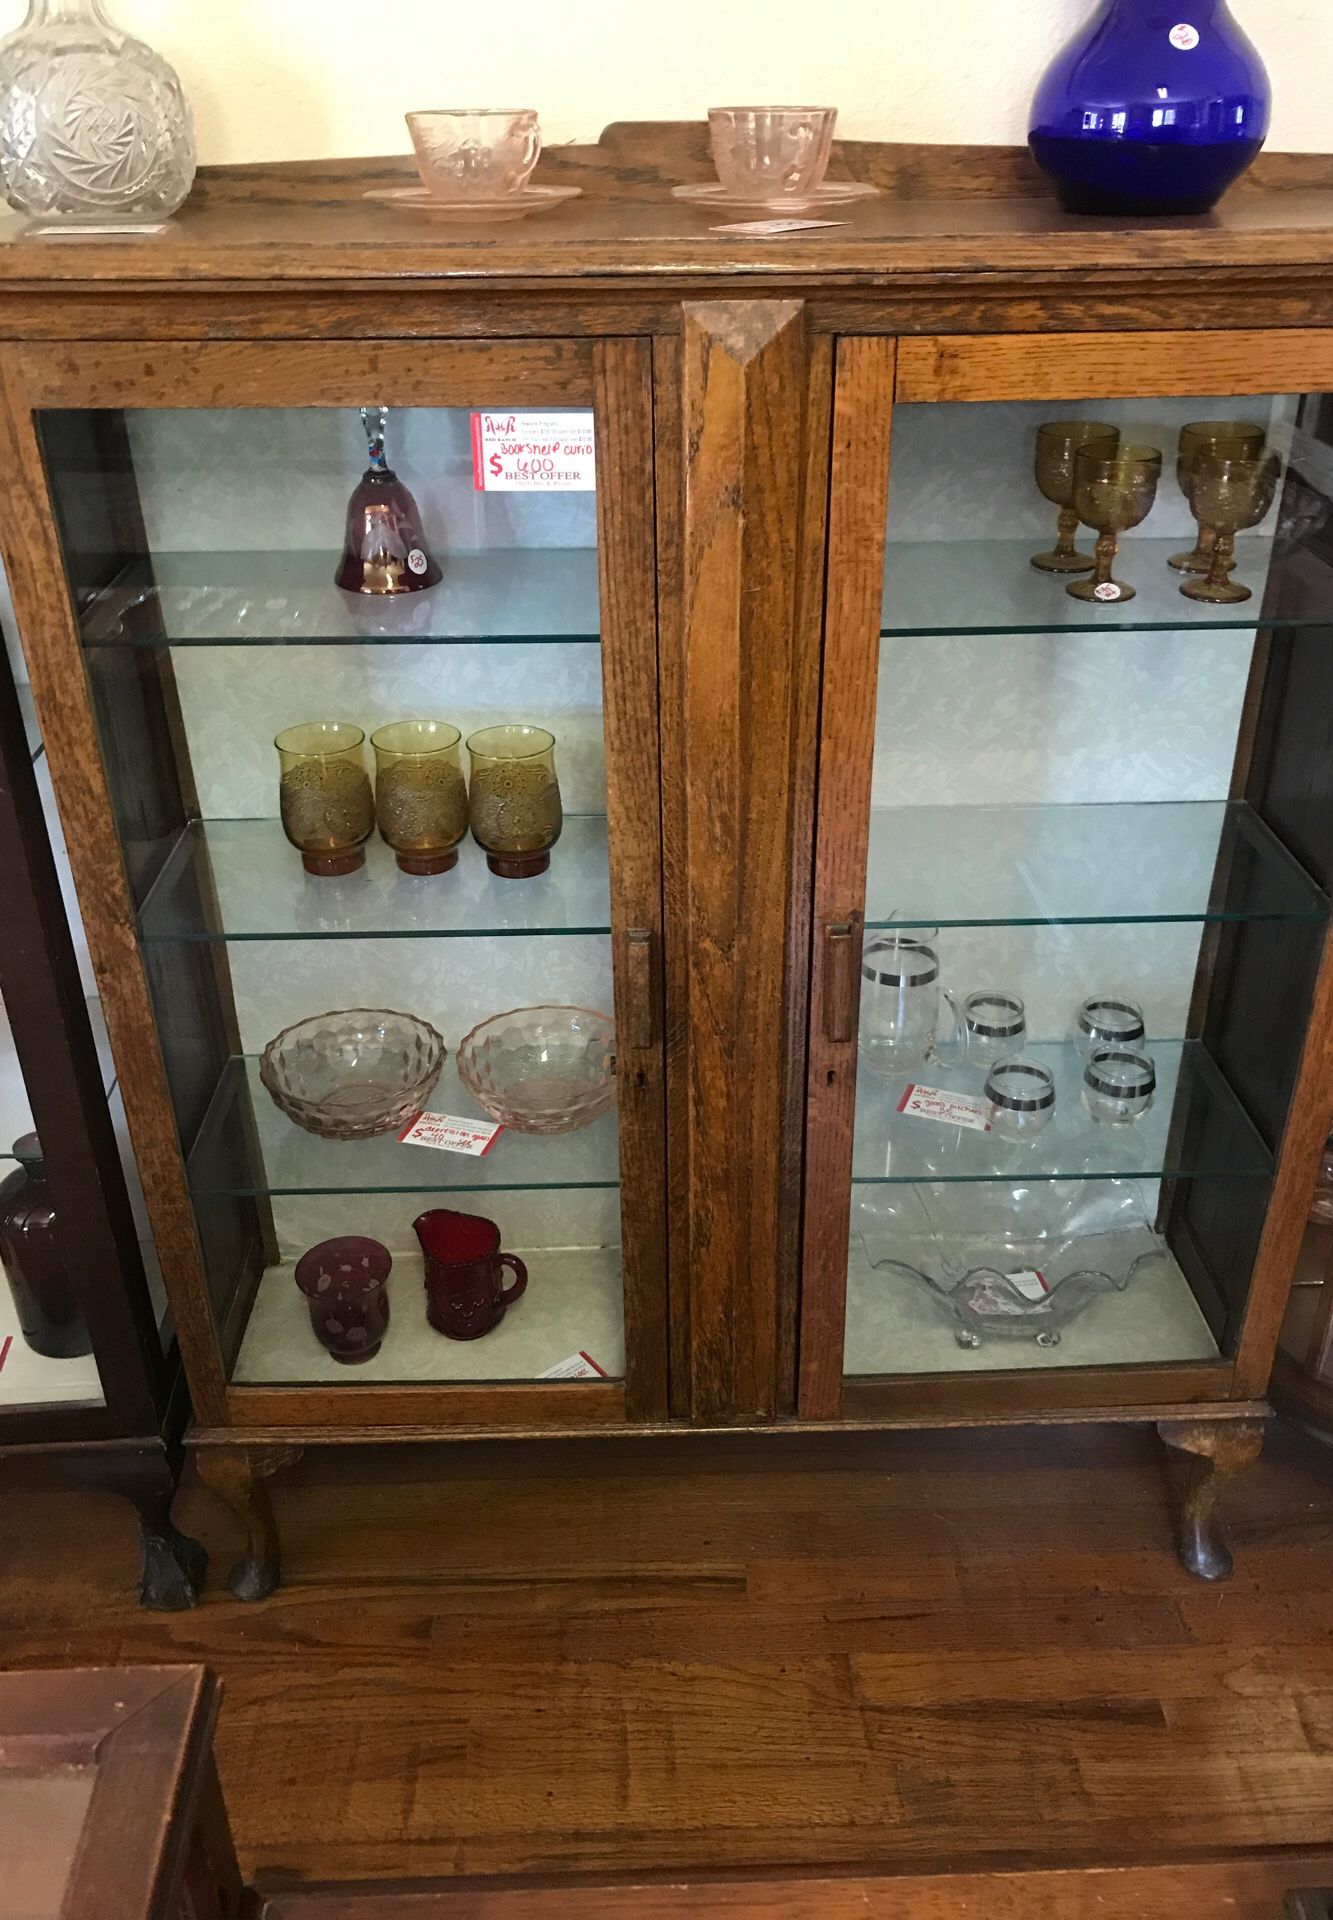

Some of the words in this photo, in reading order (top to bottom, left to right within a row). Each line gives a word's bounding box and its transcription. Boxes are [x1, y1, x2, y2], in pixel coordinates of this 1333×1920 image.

[489, 453, 503, 477] $
[505, 472, 535, 480] BEST
[540, 472, 581, 480] OFFER
